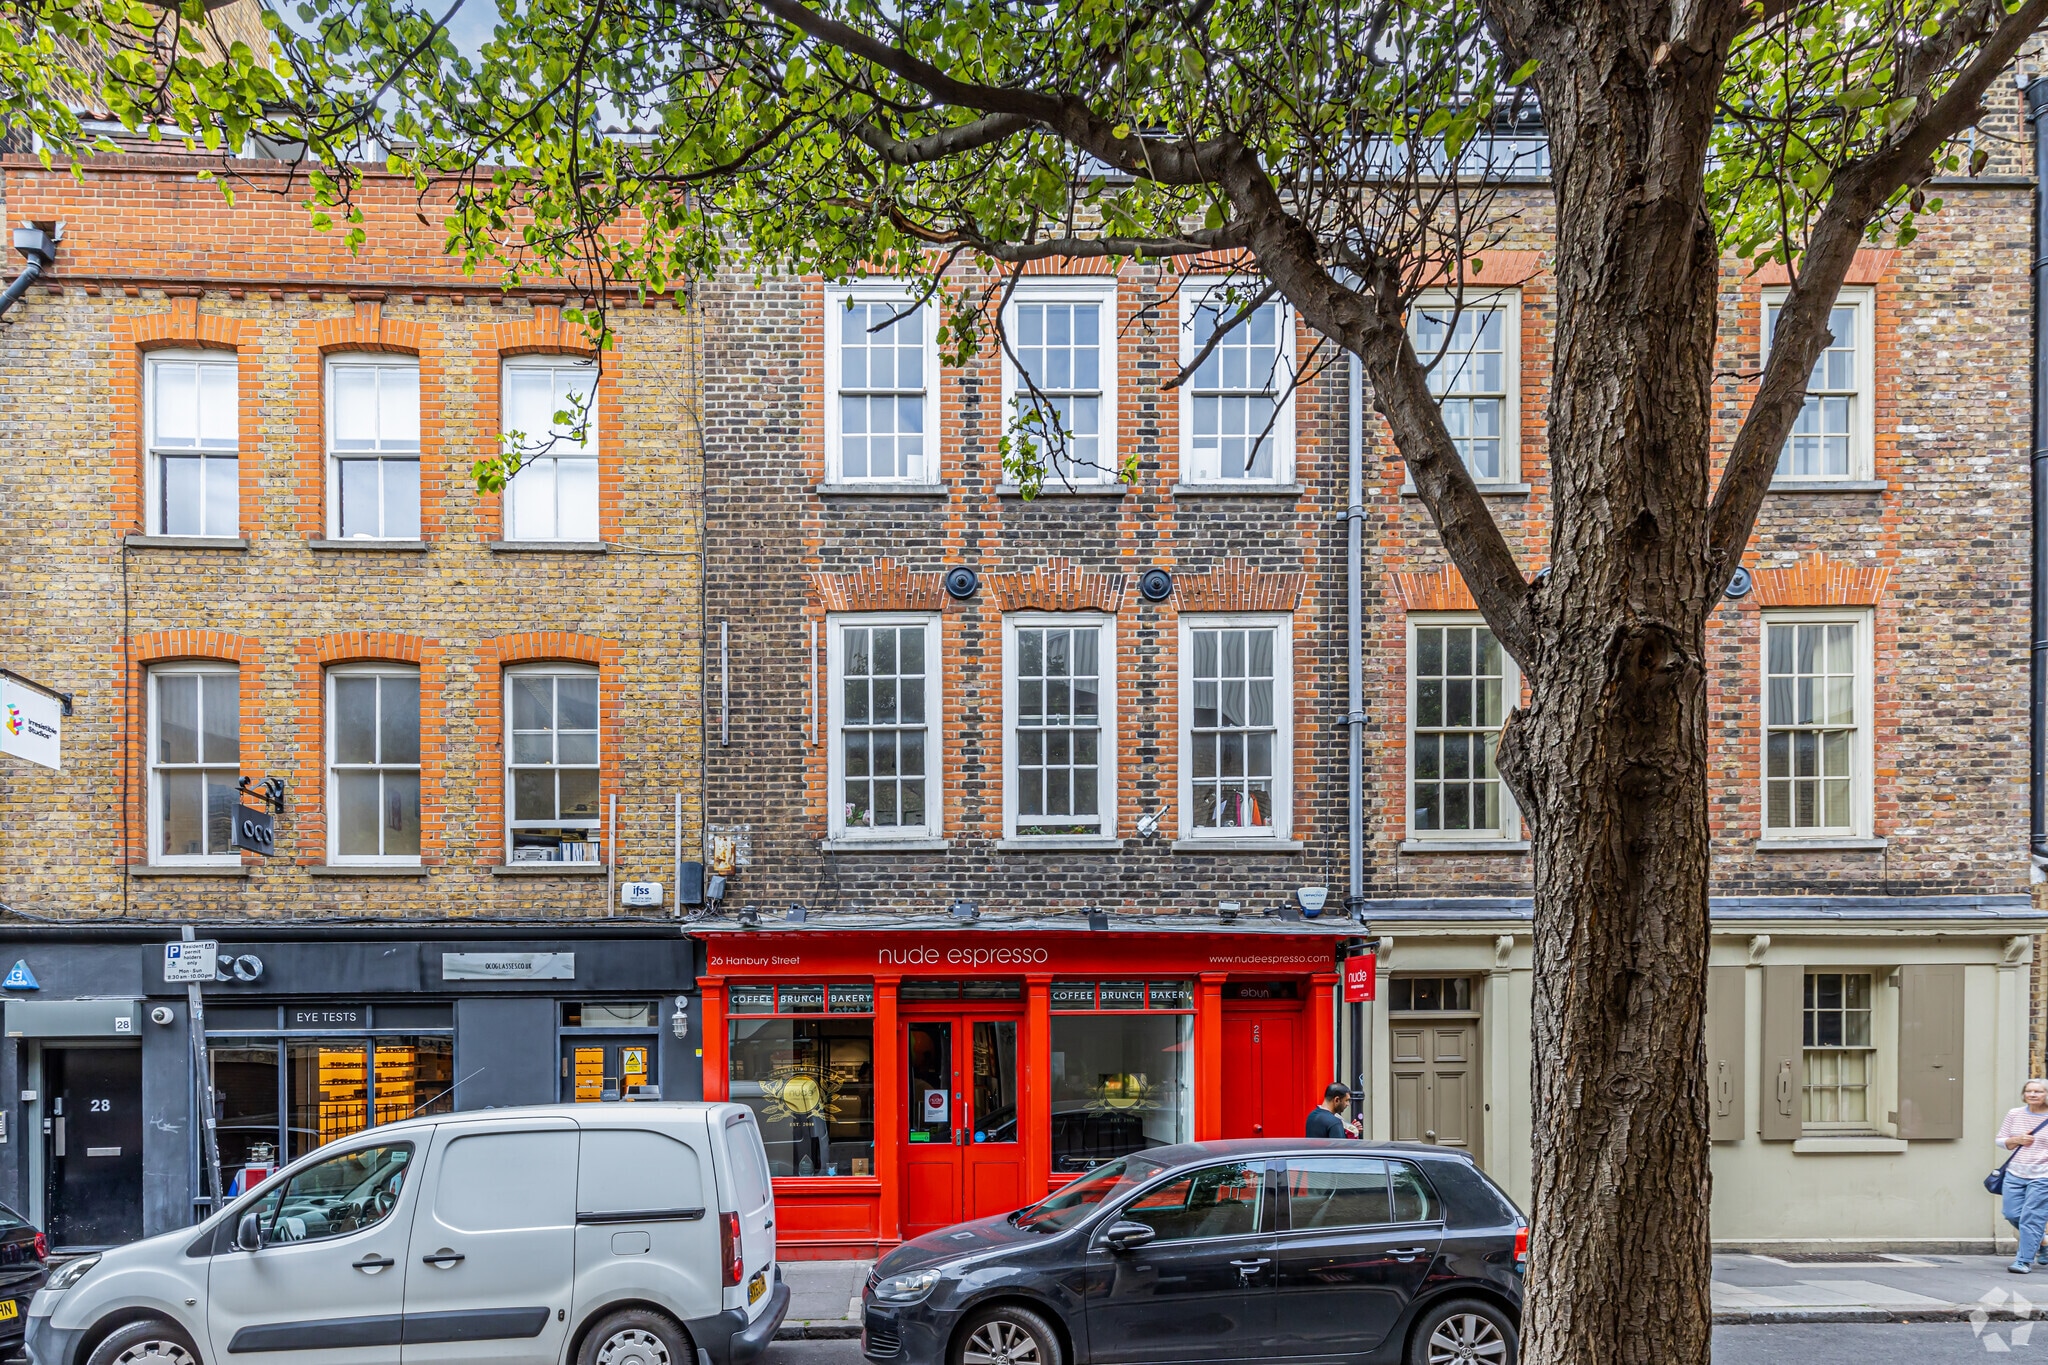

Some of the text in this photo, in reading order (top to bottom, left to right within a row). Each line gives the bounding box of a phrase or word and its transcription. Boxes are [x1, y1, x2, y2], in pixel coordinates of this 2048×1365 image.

[28, 718, 57, 735] Irresistible
[28, 726, 51, 739] Studios
[633, 885, 650, 897] ifss
[170, 946, 179, 958] P
[878, 944, 1049, 968] nude espresso
[710, 955, 800, 967] 26 Hanbury Street
[1209, 954, 1330, 965] www.nudeespresso.com
[216, 954, 263, 981] CO
[1348, 969, 1367, 983] nude
[731, 994, 871, 1004] COFFEE BRUNCH BAKERY
[1052, 990, 1191, 1000] COFFEE BRUNCH BAKERY
[296, 1012, 357, 1022] EYE TESTS
[116, 1020, 130, 1029] 28
[90, 1099, 111, 1112] 28
